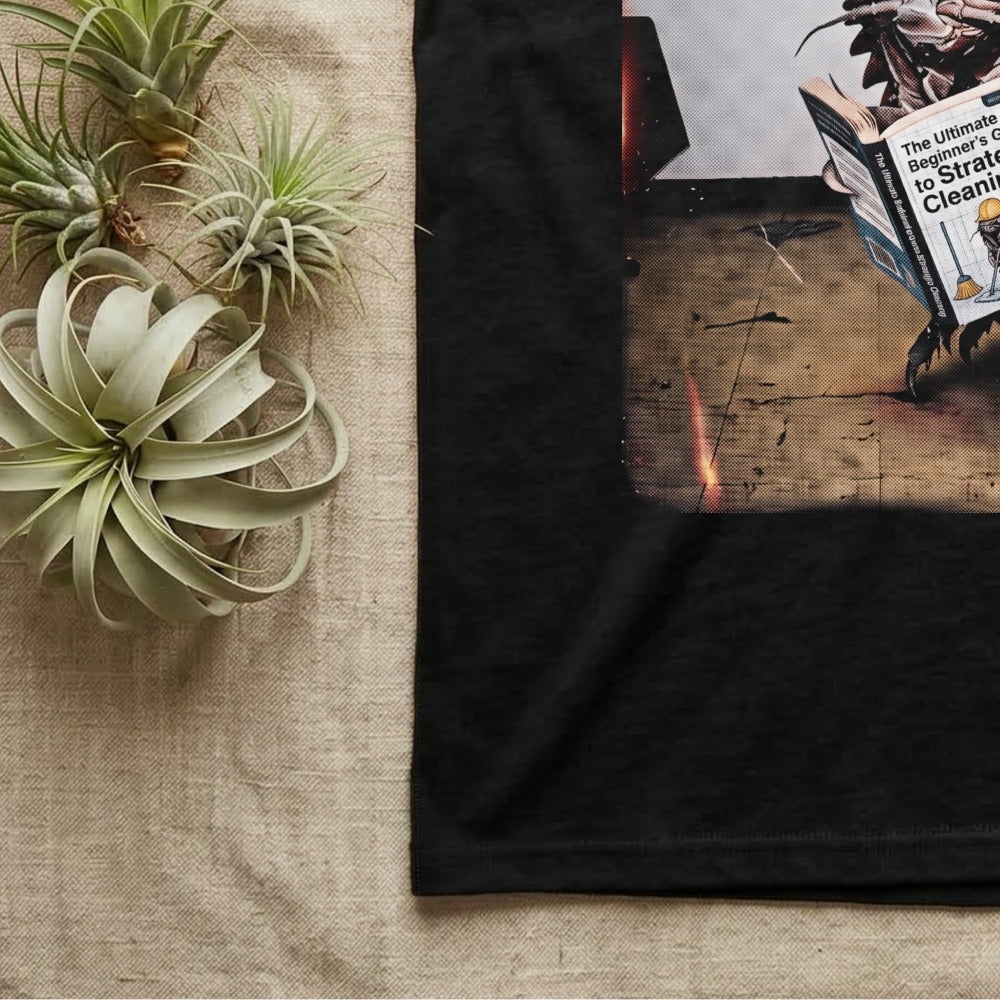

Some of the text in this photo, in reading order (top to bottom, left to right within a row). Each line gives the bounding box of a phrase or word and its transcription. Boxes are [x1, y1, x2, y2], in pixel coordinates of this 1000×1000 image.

[901, 114, 998, 156] The Ultimate
[874, 151, 886, 168] The
[907, 136, 988, 173] Beginner's
[915, 177, 935, 194] to
